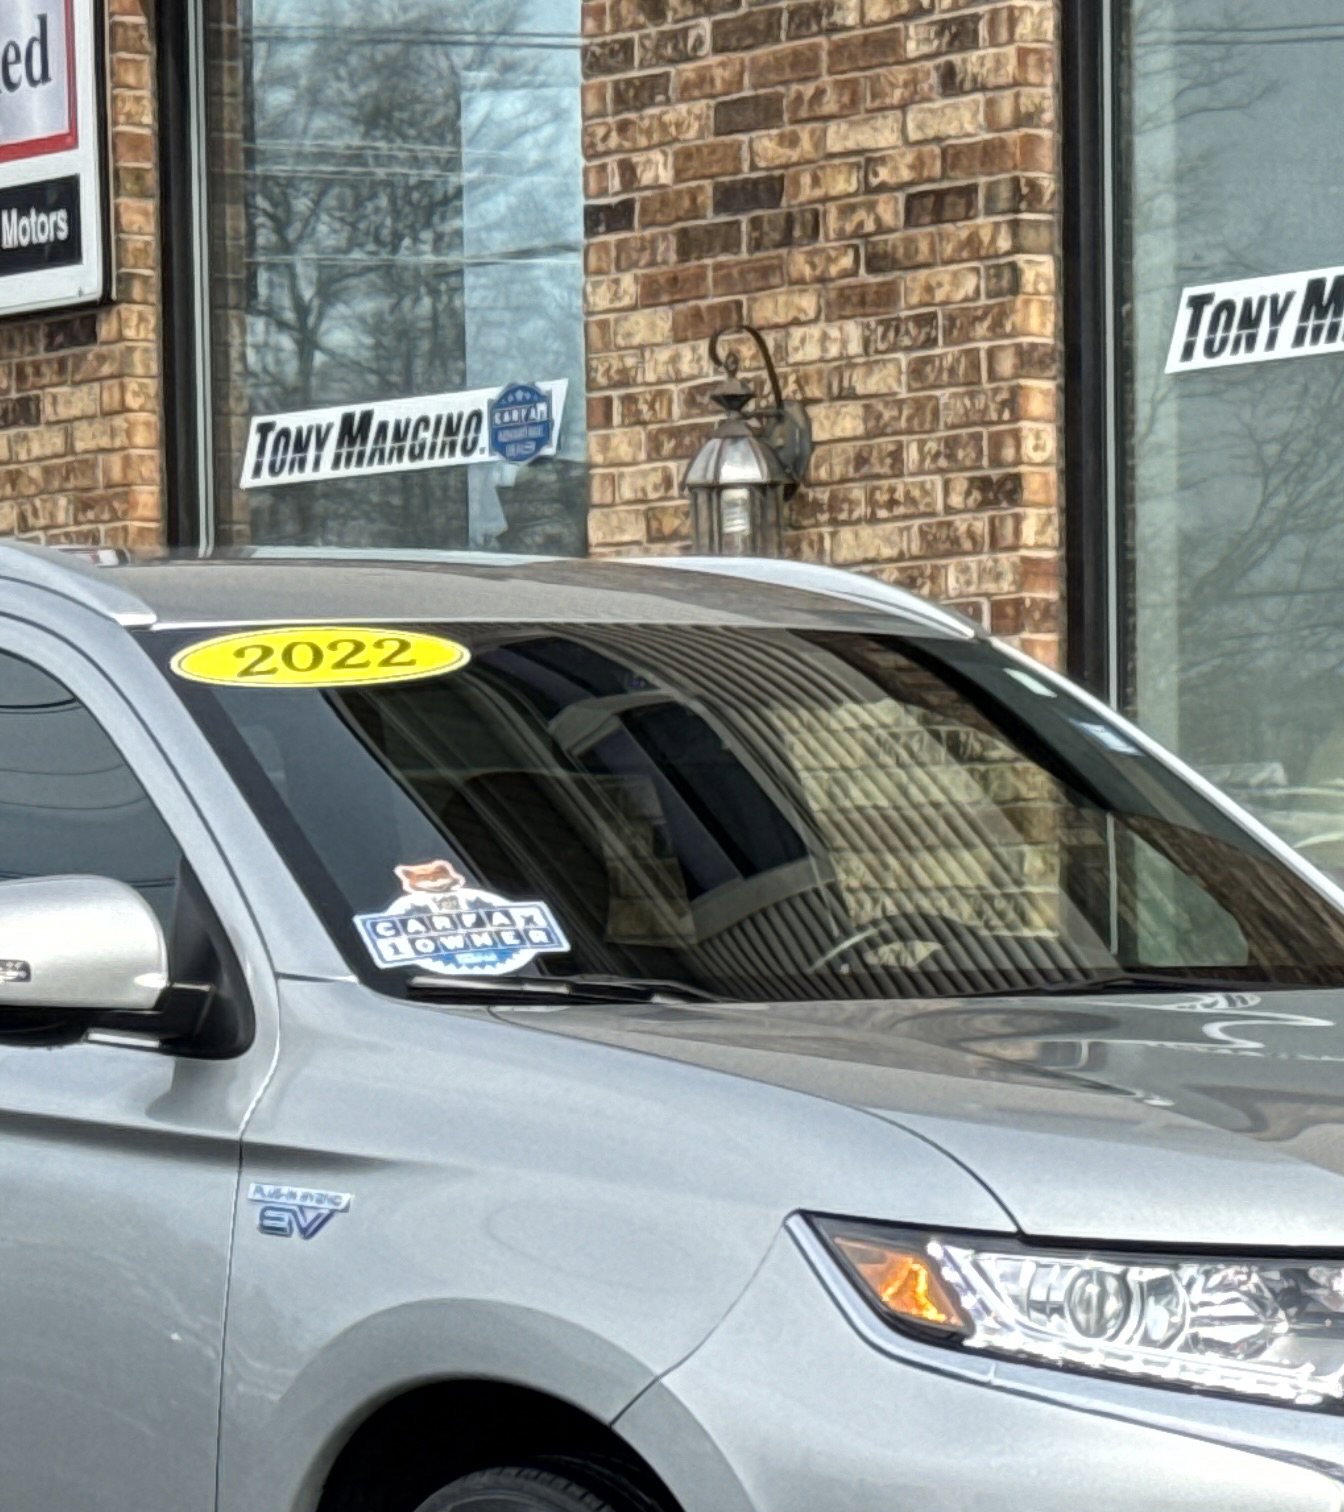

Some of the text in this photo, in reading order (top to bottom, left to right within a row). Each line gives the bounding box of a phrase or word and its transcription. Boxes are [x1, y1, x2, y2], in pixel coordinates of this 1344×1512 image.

[1, 206, 69, 250] Motors
[1179, 290, 1297, 363] TONY
[250, 420, 335, 480] TONY
[232, 637, 417, 678] 2022
[373, 910, 540, 938] CARFAX
[413, 930, 553, 954] OWNER
